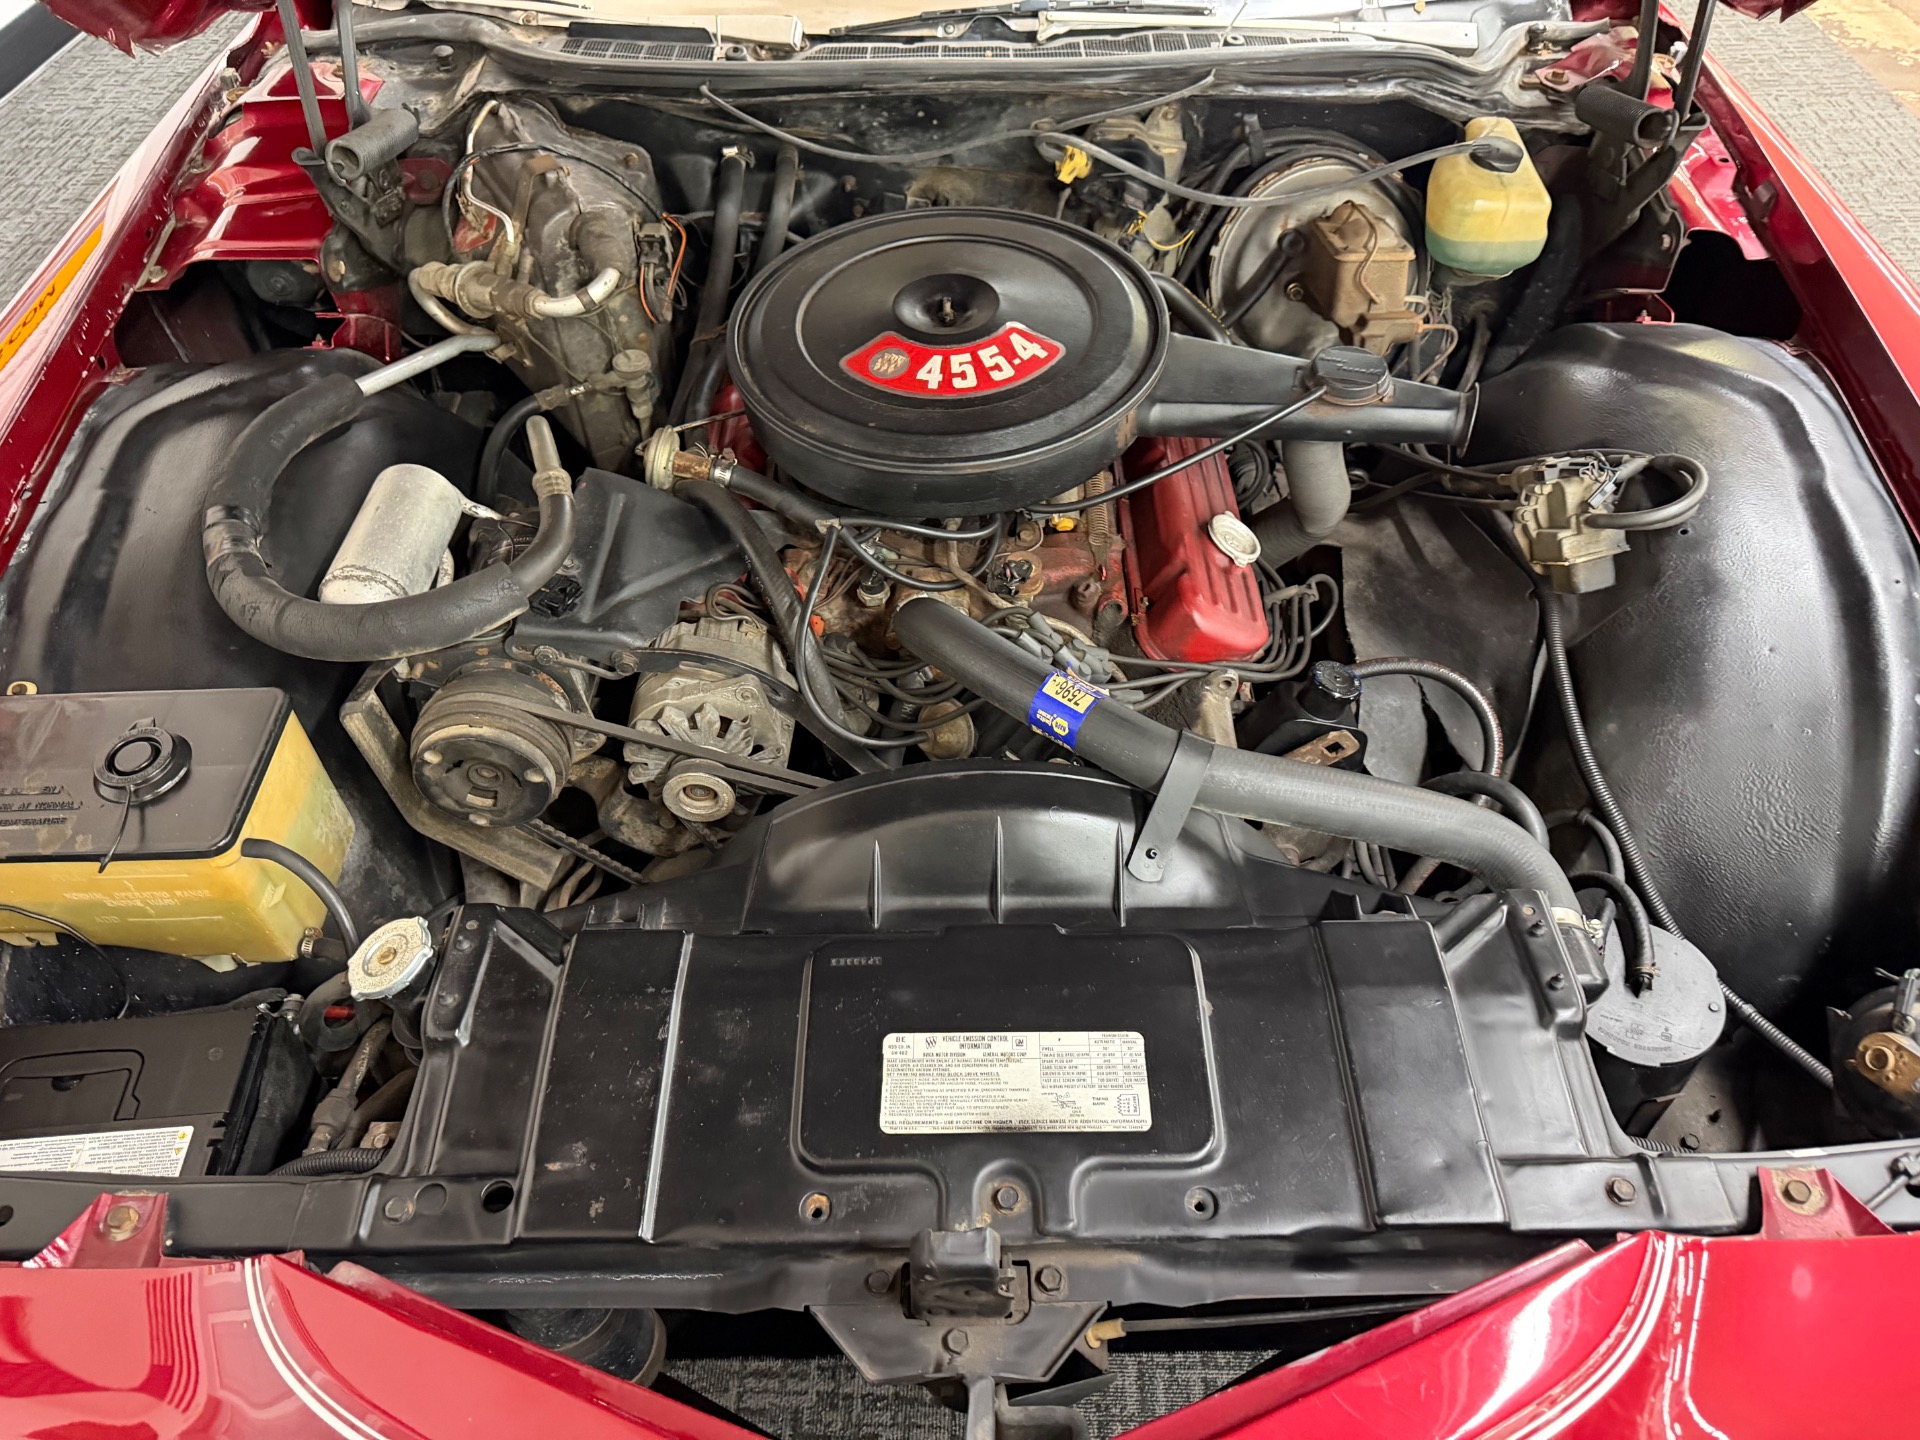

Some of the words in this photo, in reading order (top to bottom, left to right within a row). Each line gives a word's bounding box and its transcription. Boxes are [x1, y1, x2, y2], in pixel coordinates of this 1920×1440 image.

[916, 332, 1049, 389] 455.4
[1055, 680, 1086, 707] 7596
[942, 1035, 960, 1043] VEHICLE
[962, 1035, 985, 1043] EMISSION
[987, 1035, 1009, 1043] CONTROL
[959, 1042, 992, 1050] INFORMATION
